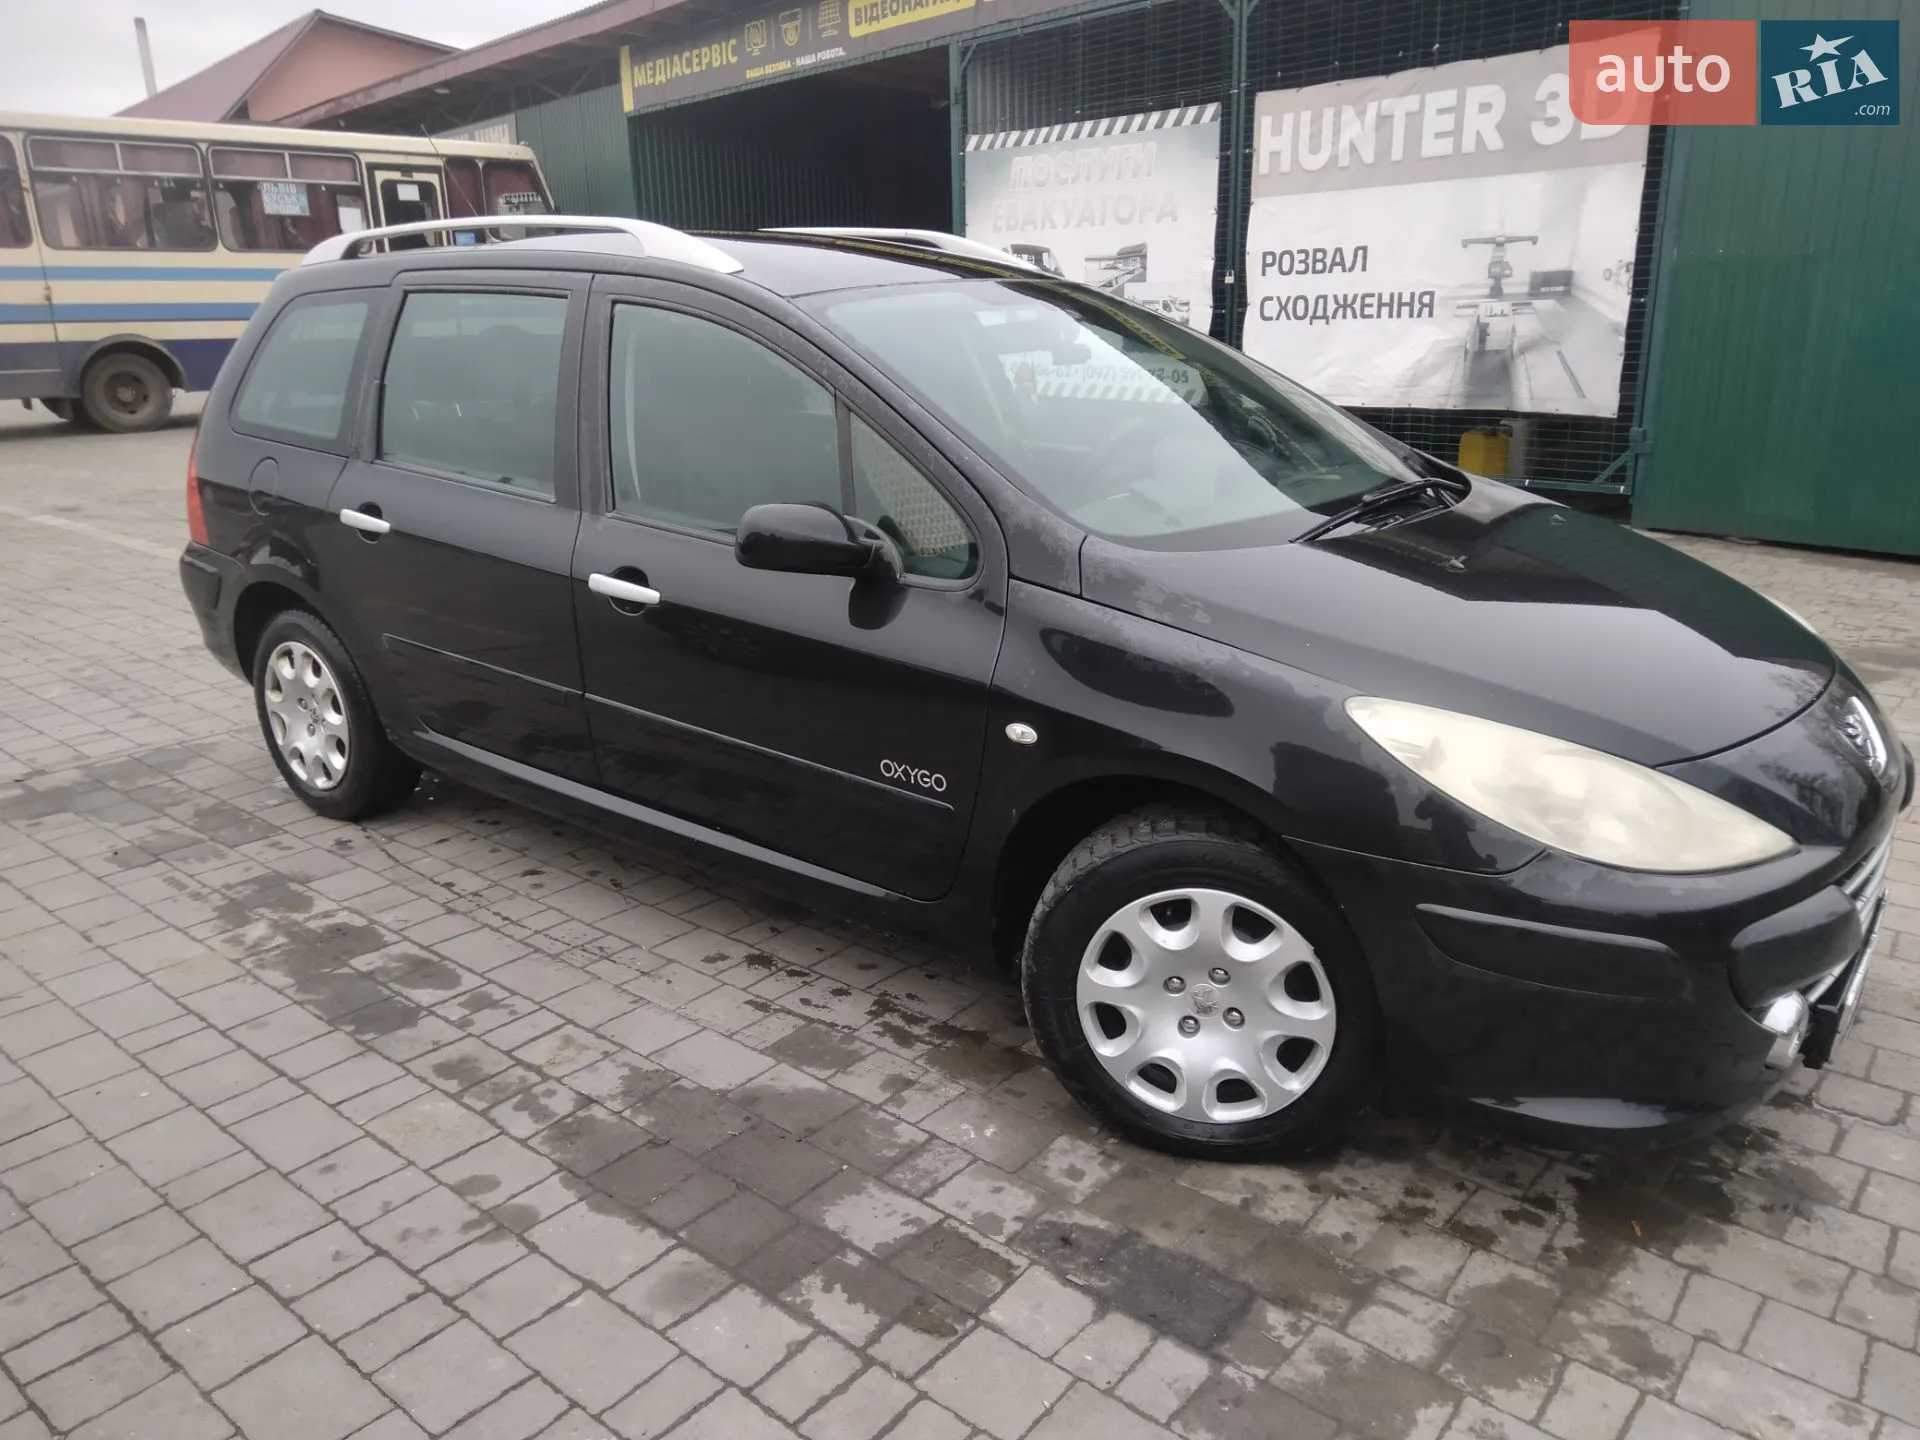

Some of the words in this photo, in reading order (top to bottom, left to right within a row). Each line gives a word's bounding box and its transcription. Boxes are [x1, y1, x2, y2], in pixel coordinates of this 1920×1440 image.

[633, 38, 738, 88] МЕДІАСЕРВІС
[795, 52, 817, 66] НАША
[1258, 84, 1507, 175] HUNTER
[1530, 67, 1640, 146] 3D
[1008, 141, 1157, 192] ПОСЛУГИ
[992, 189, 1178, 233] ЕВАКУАТОРА
[1261, 245, 1369, 277] РОЗВАЛ
[1259, 290, 1436, 325] СХОДЖЕННЯ
[880, 759, 947, 792] OXYGO
